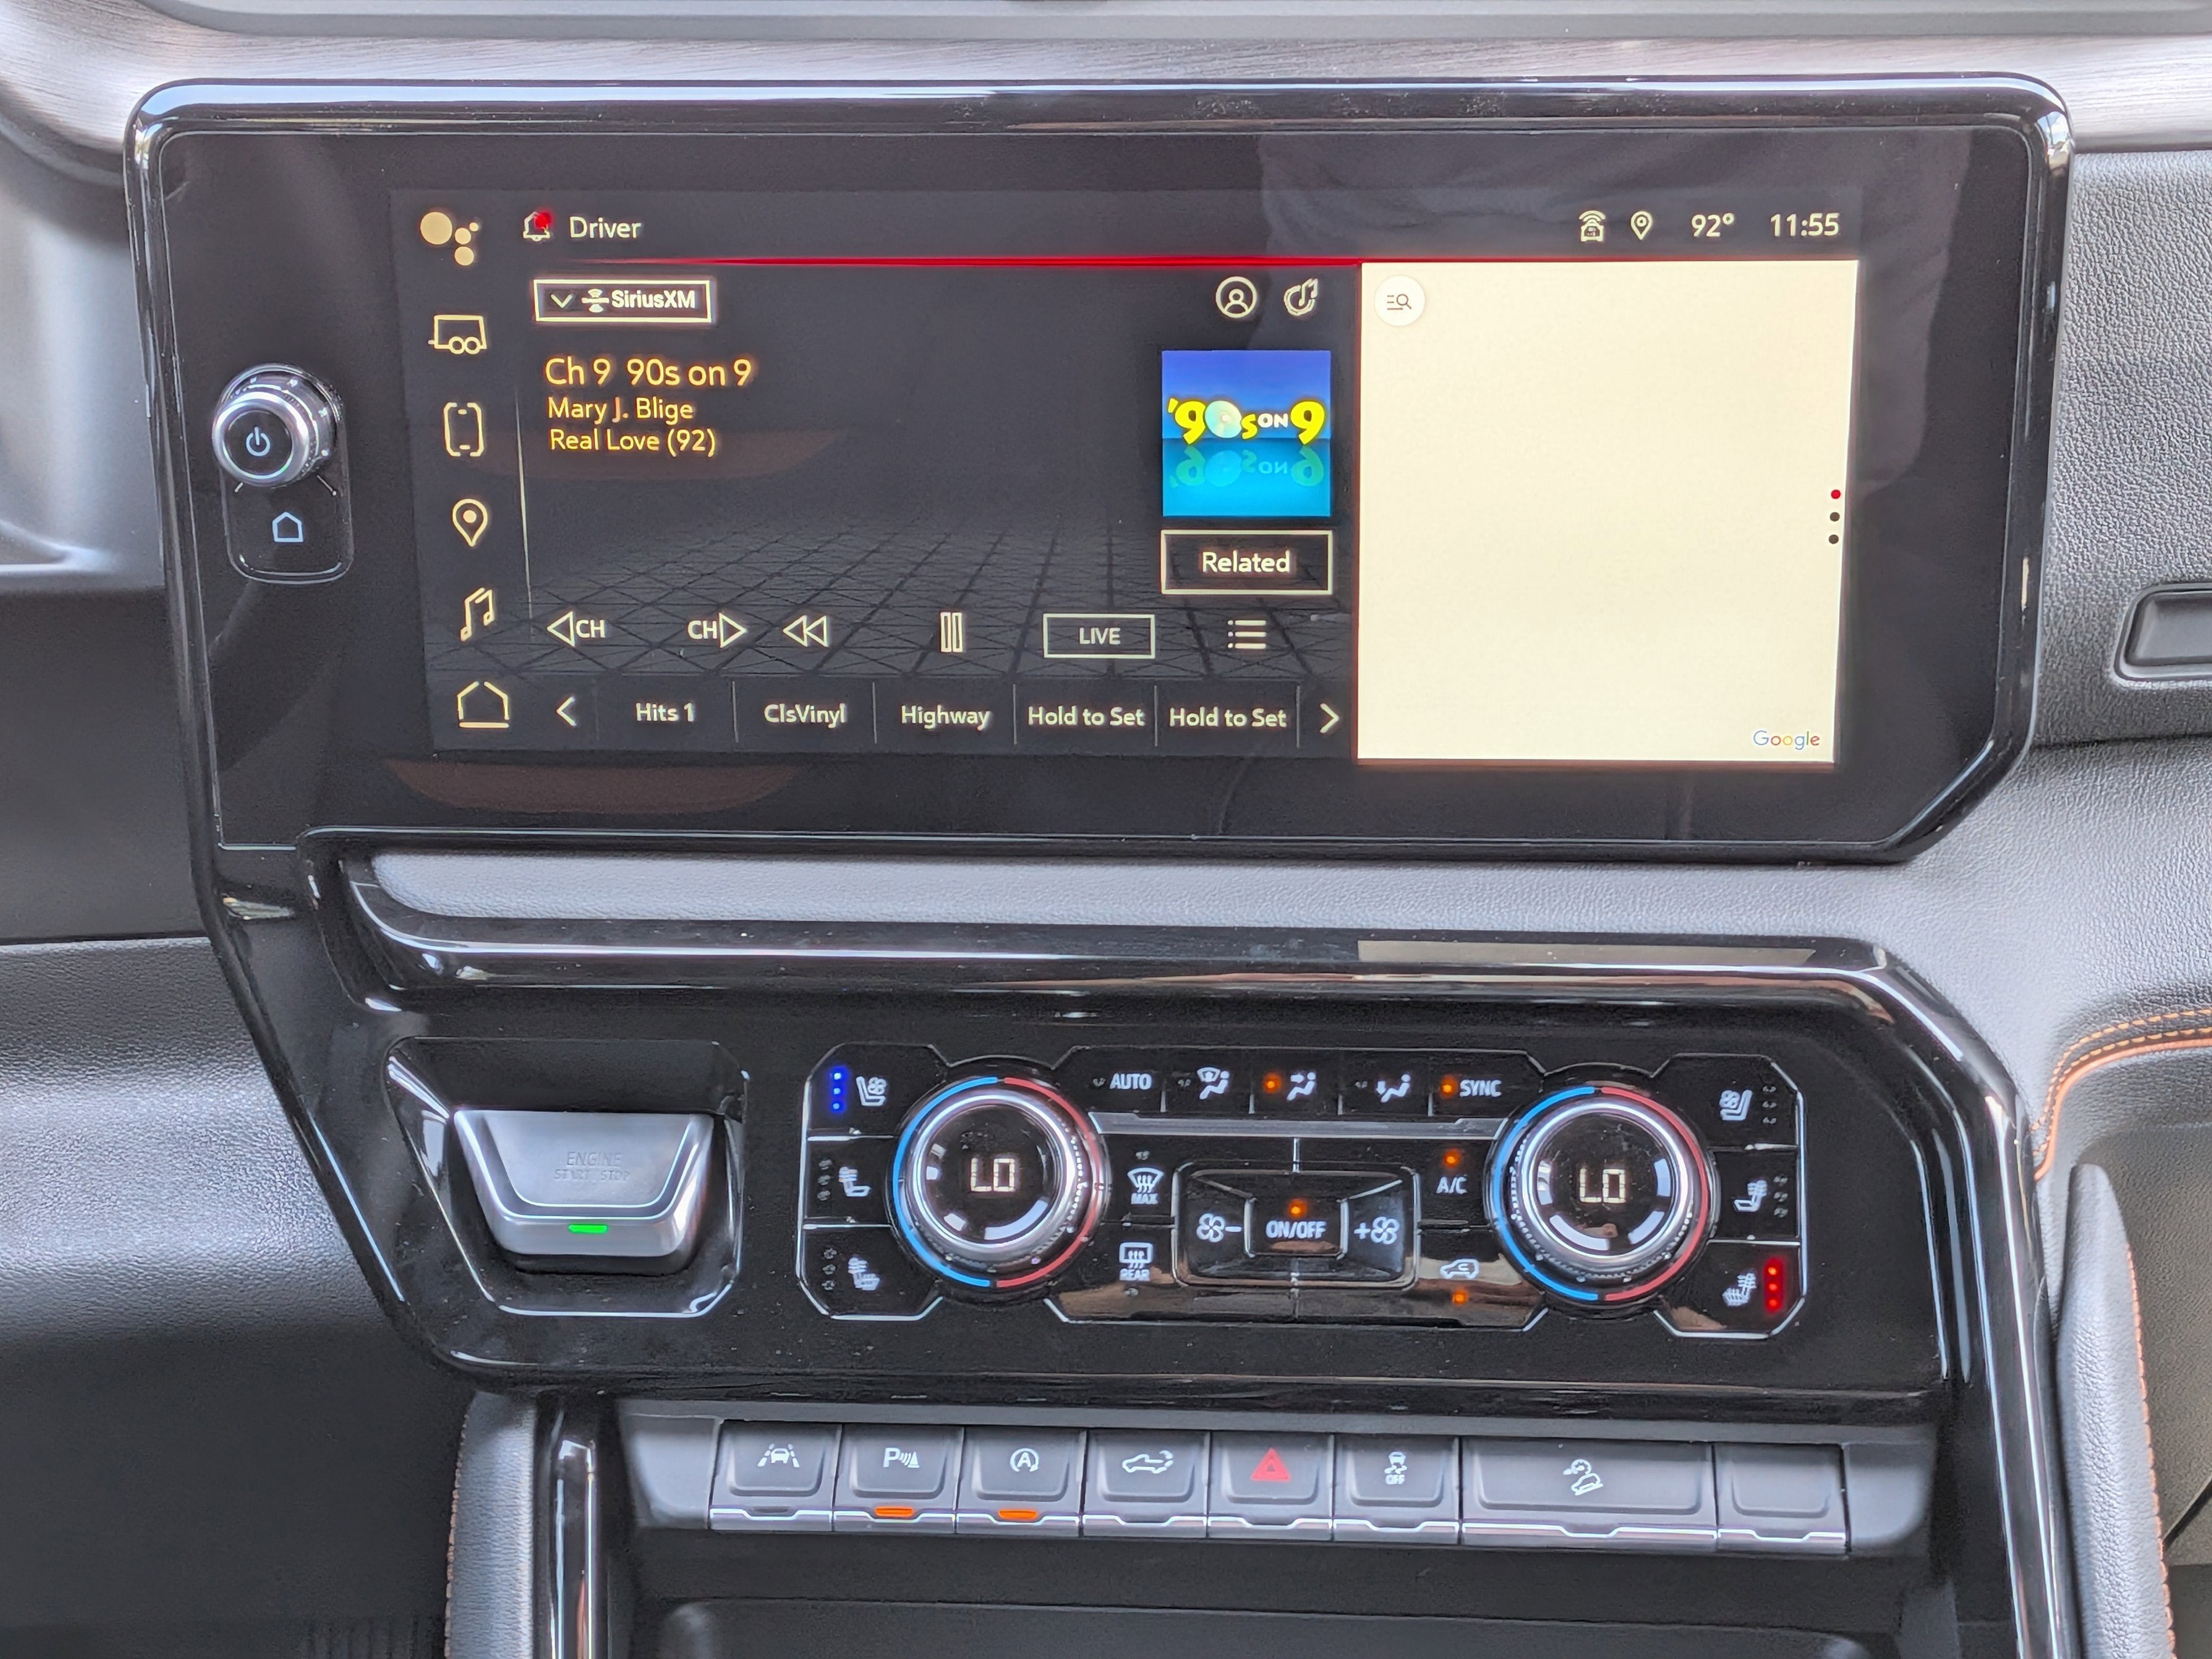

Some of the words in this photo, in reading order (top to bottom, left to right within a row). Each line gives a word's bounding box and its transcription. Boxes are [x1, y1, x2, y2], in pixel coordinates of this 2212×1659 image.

[569, 216, 642, 239] Driver
[1770, 212, 1840, 237] 11:55
[611, 289, 696, 310] SiriusXM
[545, 358, 585, 386] Ch
[593, 358, 611, 387] 9
[626, 358, 681, 387] 90s
[688, 364, 726, 387] on
[733, 358, 752, 387] 9
[547, 397, 608, 425] Mary
[612, 397, 629, 422] J.
[636, 397, 694, 425] Blige
[1257, 413, 1288, 429] ON
[1290, 400, 1326, 445] 9
[550, 429, 599, 451] Real
[607, 430, 660, 451] Love
[666, 429, 716, 457] (92)
[1202, 549, 1291, 573] Related
[576, 619, 606, 639] CH
[687, 620, 718, 640] CH
[1079, 627, 1121, 645] LIVE
[635, 702, 679, 722] Hits
[683, 703, 696, 722] 1
[764, 702, 846, 729] ClsVinyl
[900, 705, 992, 731] Highway
[1027, 706, 1078, 727] Hold
[1083, 708, 1105, 727] to
[1109, 707, 1145, 727] Set
[1169, 707, 1219, 727] Hold
[1224, 709, 1246, 727] to
[1251, 708, 1287, 728] Set
[1753, 730, 1820, 750] Google
[1110, 1073, 1152, 1091] AUTO
[1459, 1079, 1502, 1097] SYNC
[566, 1151, 623, 1167] ENGINE
[970, 1157, 1016, 1192] LO
[1437, 1177, 1467, 1194] A/C
[1579, 1168, 1626, 1203] LO
[1131, 1193, 1158, 1204] MAX
[1266, 1220, 1327, 1239] ON/OFF
[1120, 1269, 1150, 1281] REAR
[1386, 1474, 1405, 1484] OFF
